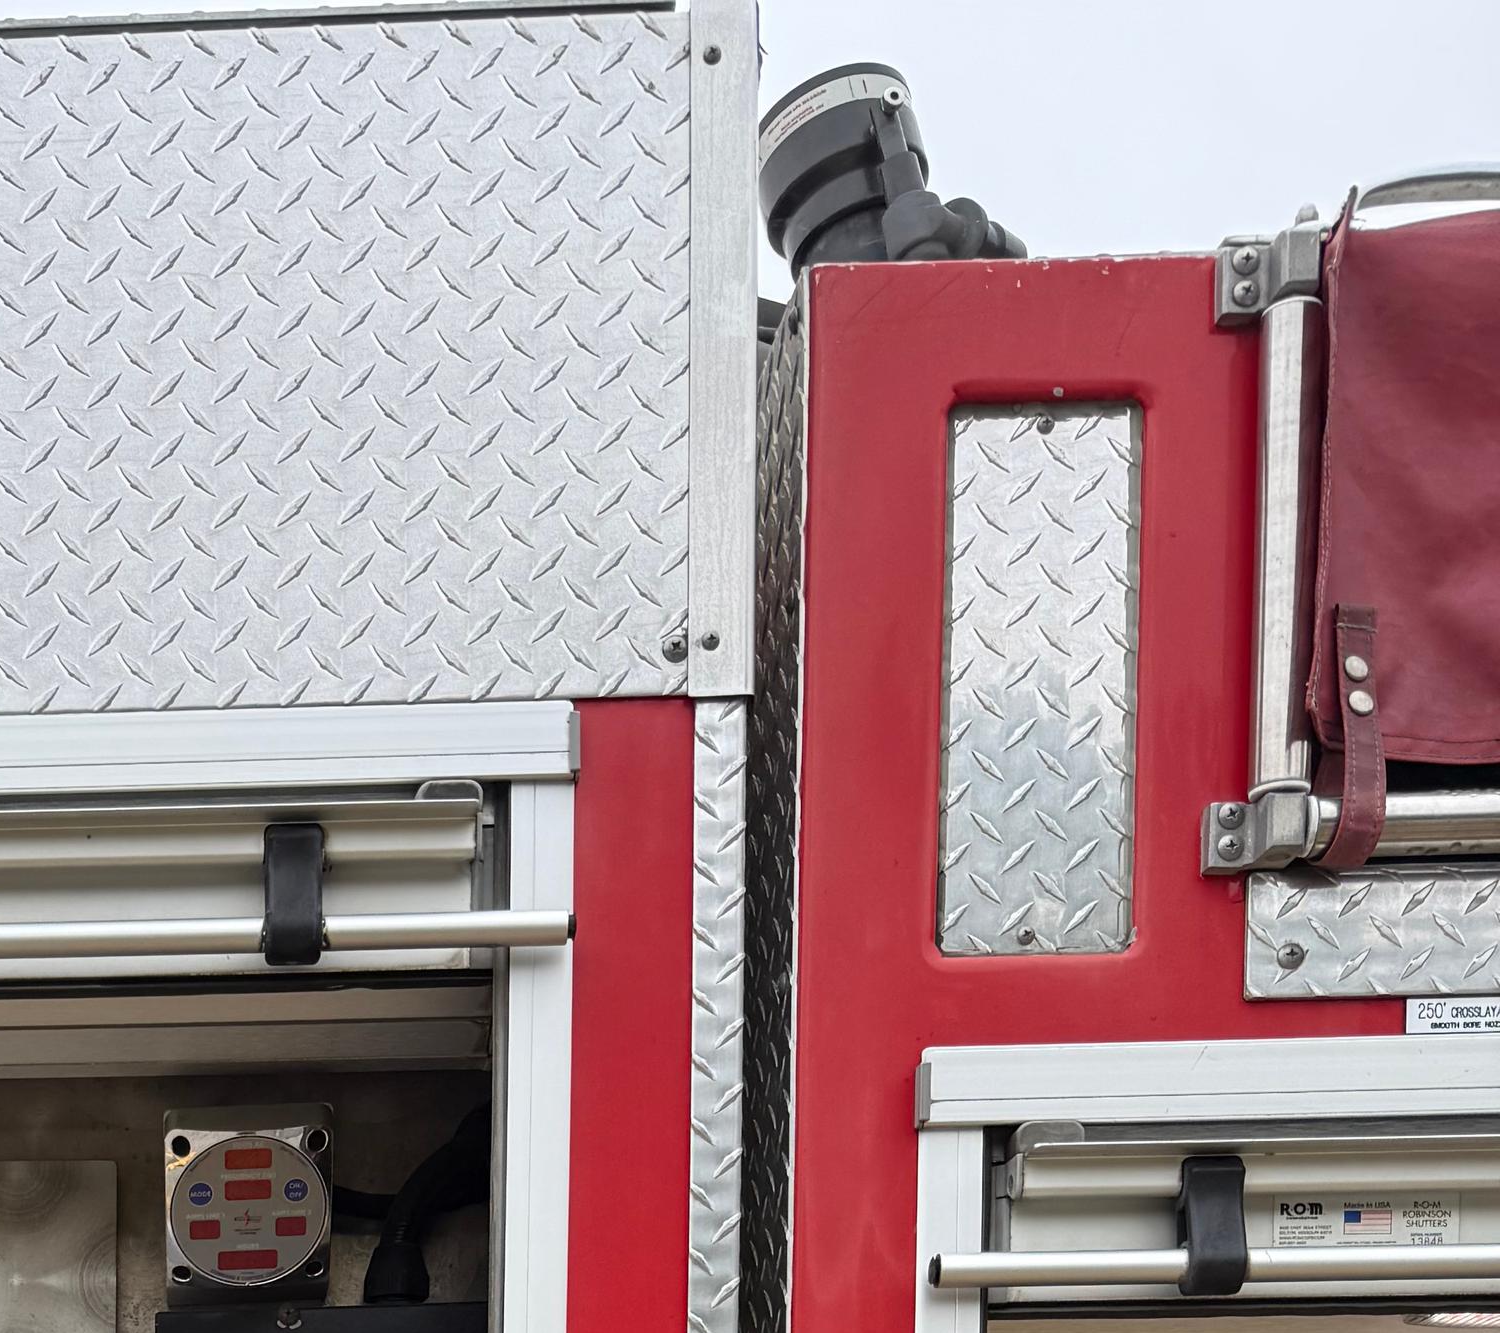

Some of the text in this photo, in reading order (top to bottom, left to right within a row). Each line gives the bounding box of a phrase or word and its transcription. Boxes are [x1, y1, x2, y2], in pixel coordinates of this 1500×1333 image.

[1430, 1021, 1460, 1029] SMOOTH
[1402, 1209, 1451, 1219] ROBINSON
[1405, 1219, 1448, 1228] SHUTTERS
